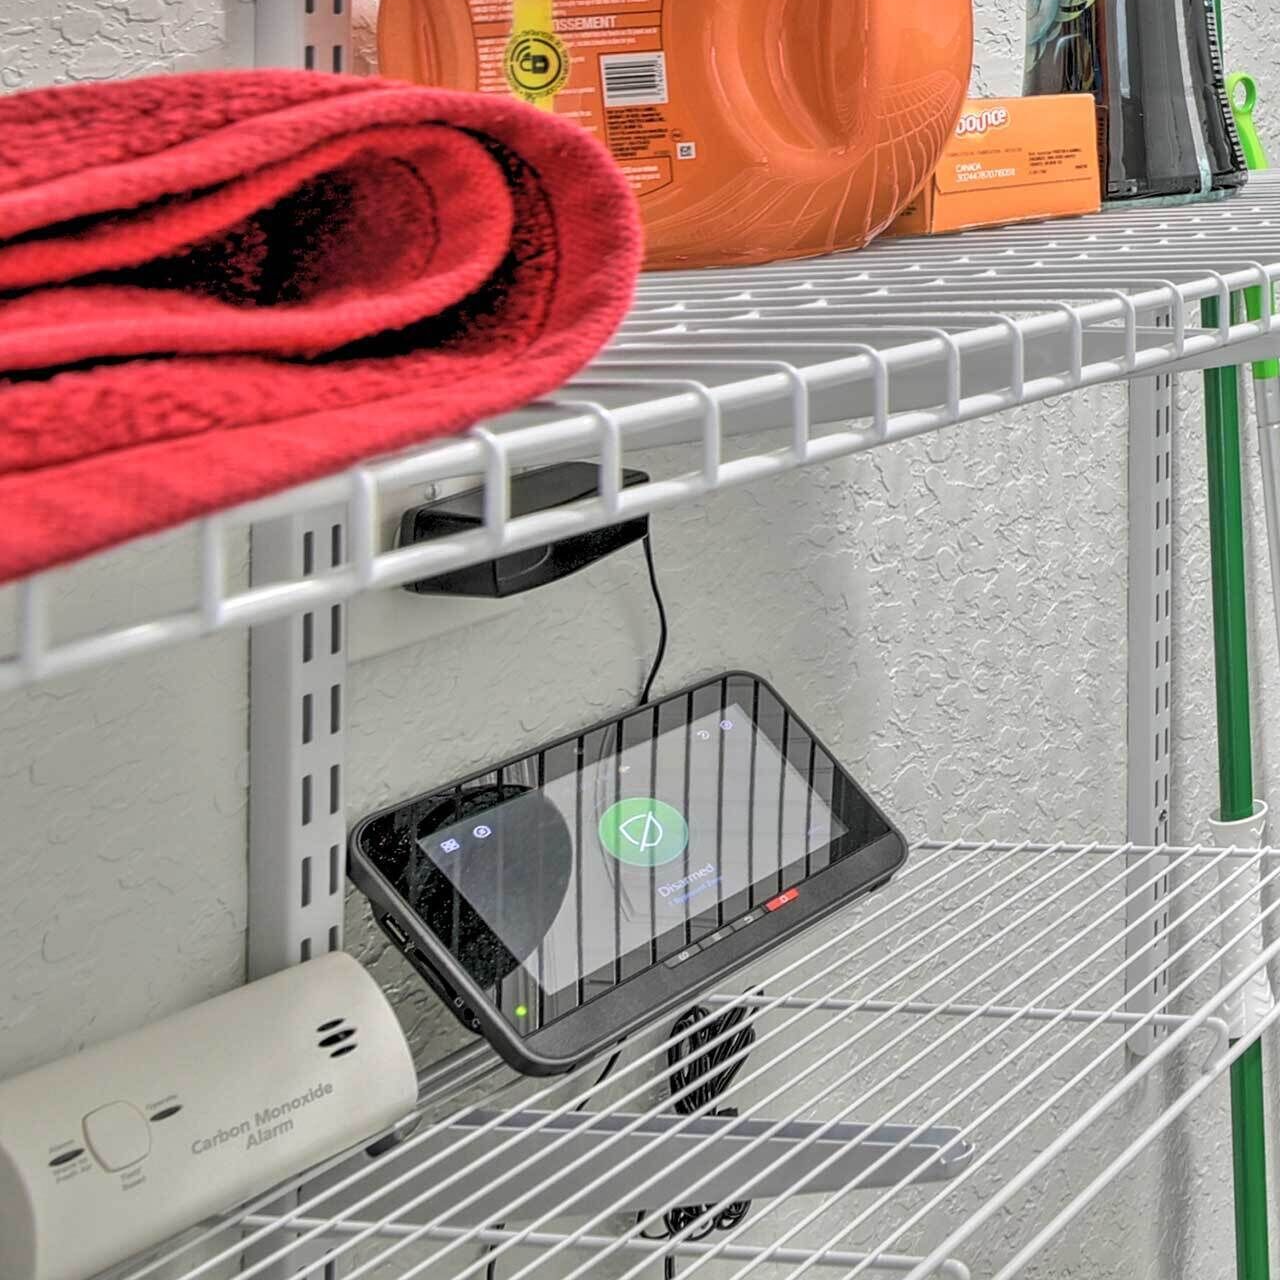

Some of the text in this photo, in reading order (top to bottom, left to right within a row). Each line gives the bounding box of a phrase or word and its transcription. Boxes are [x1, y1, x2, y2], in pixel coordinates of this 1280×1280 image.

[658, 864, 715, 898] Disarmed
[191, 1082, 333, 1155] Carbon Monoxide
[246, 1119, 294, 1150] Alarm
